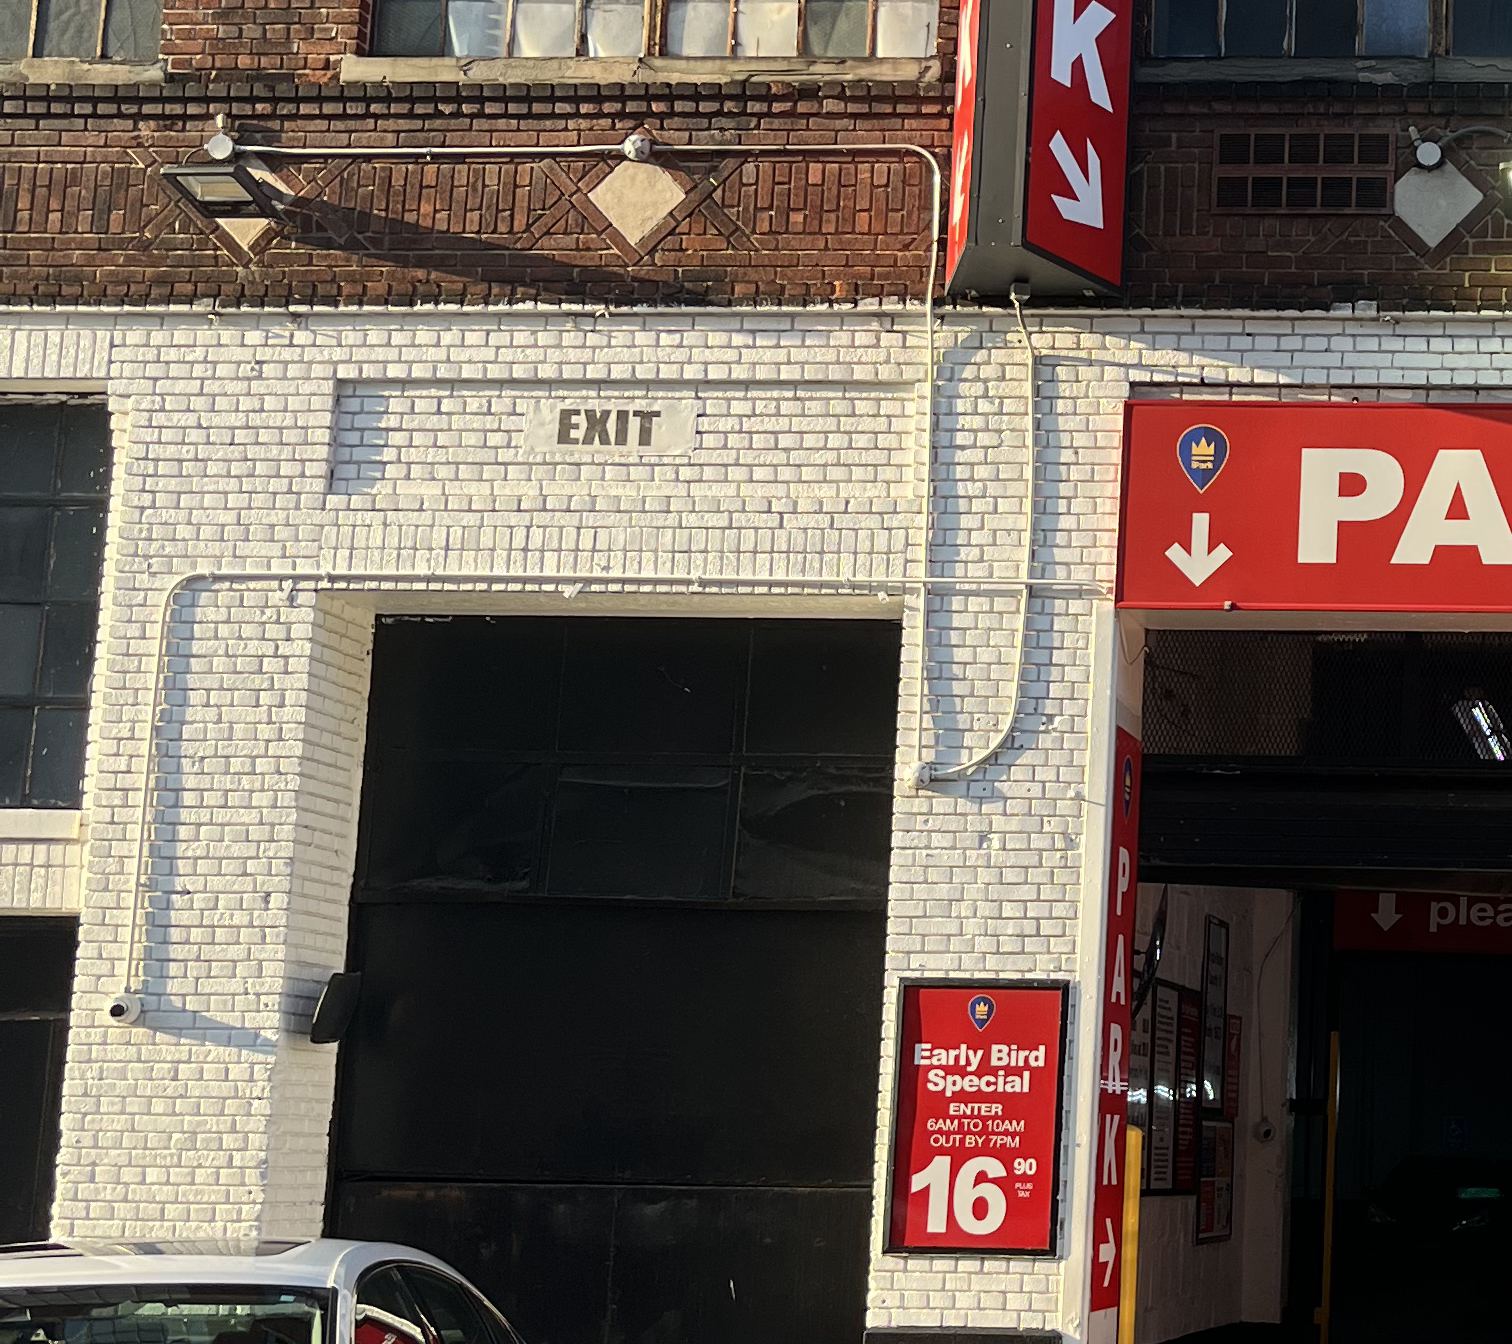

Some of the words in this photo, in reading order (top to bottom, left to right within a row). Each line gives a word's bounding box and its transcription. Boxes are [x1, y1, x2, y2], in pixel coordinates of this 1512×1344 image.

[556, 408, 662, 447] EXIT
[1103, 846, 1130, 1186] PARK
[914, 1043, 984, 1072] Early
[990, 1044, 1046, 1067] Bird
[927, 1069, 1031, 1097] Special
[949, 1102, 1003, 1116] ENTER
[927, 1118, 959, 1131] 6AM
[961, 1119, 983, 1132] TO
[986, 1120, 1025, 1132] 10AM
[930, 1134, 963, 1147] OUT
[965, 1135, 986, 1148] BY
[989, 1136, 1020, 1148] 7PM
[910, 1155, 1008, 1236] 16
[1013, 1157, 1037, 1175] 90
[1014, 1182, 1034, 1190] PLUS
[1017, 1189, 1030, 1198] TAX
